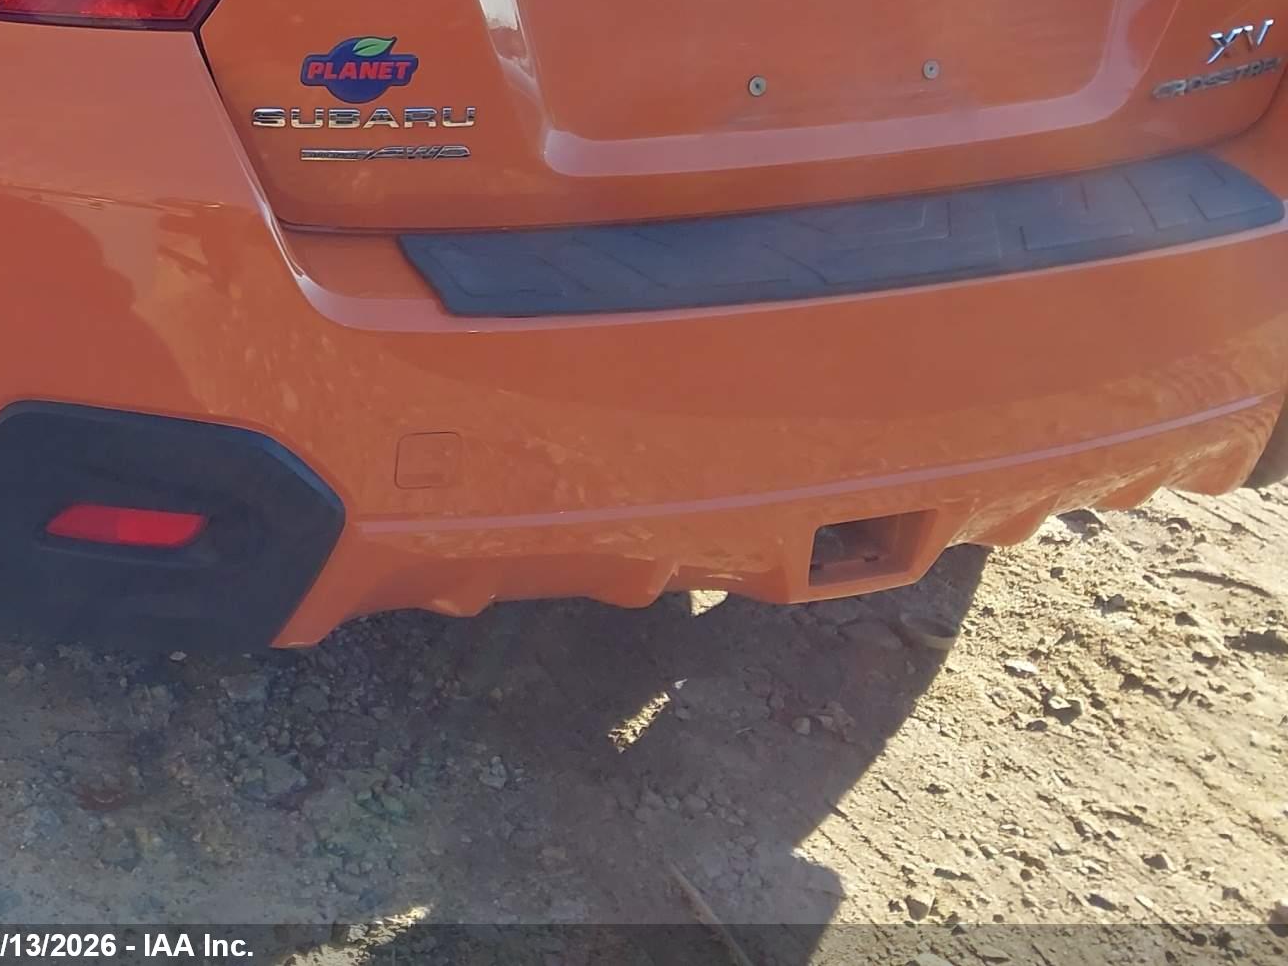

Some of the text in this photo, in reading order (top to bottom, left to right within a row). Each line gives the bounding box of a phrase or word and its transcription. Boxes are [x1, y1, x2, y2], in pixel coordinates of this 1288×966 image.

[1206, 18, 1275, 65] XV
[306, 61, 413, 80] PLANET
[251, 106, 477, 129] SUBARU
